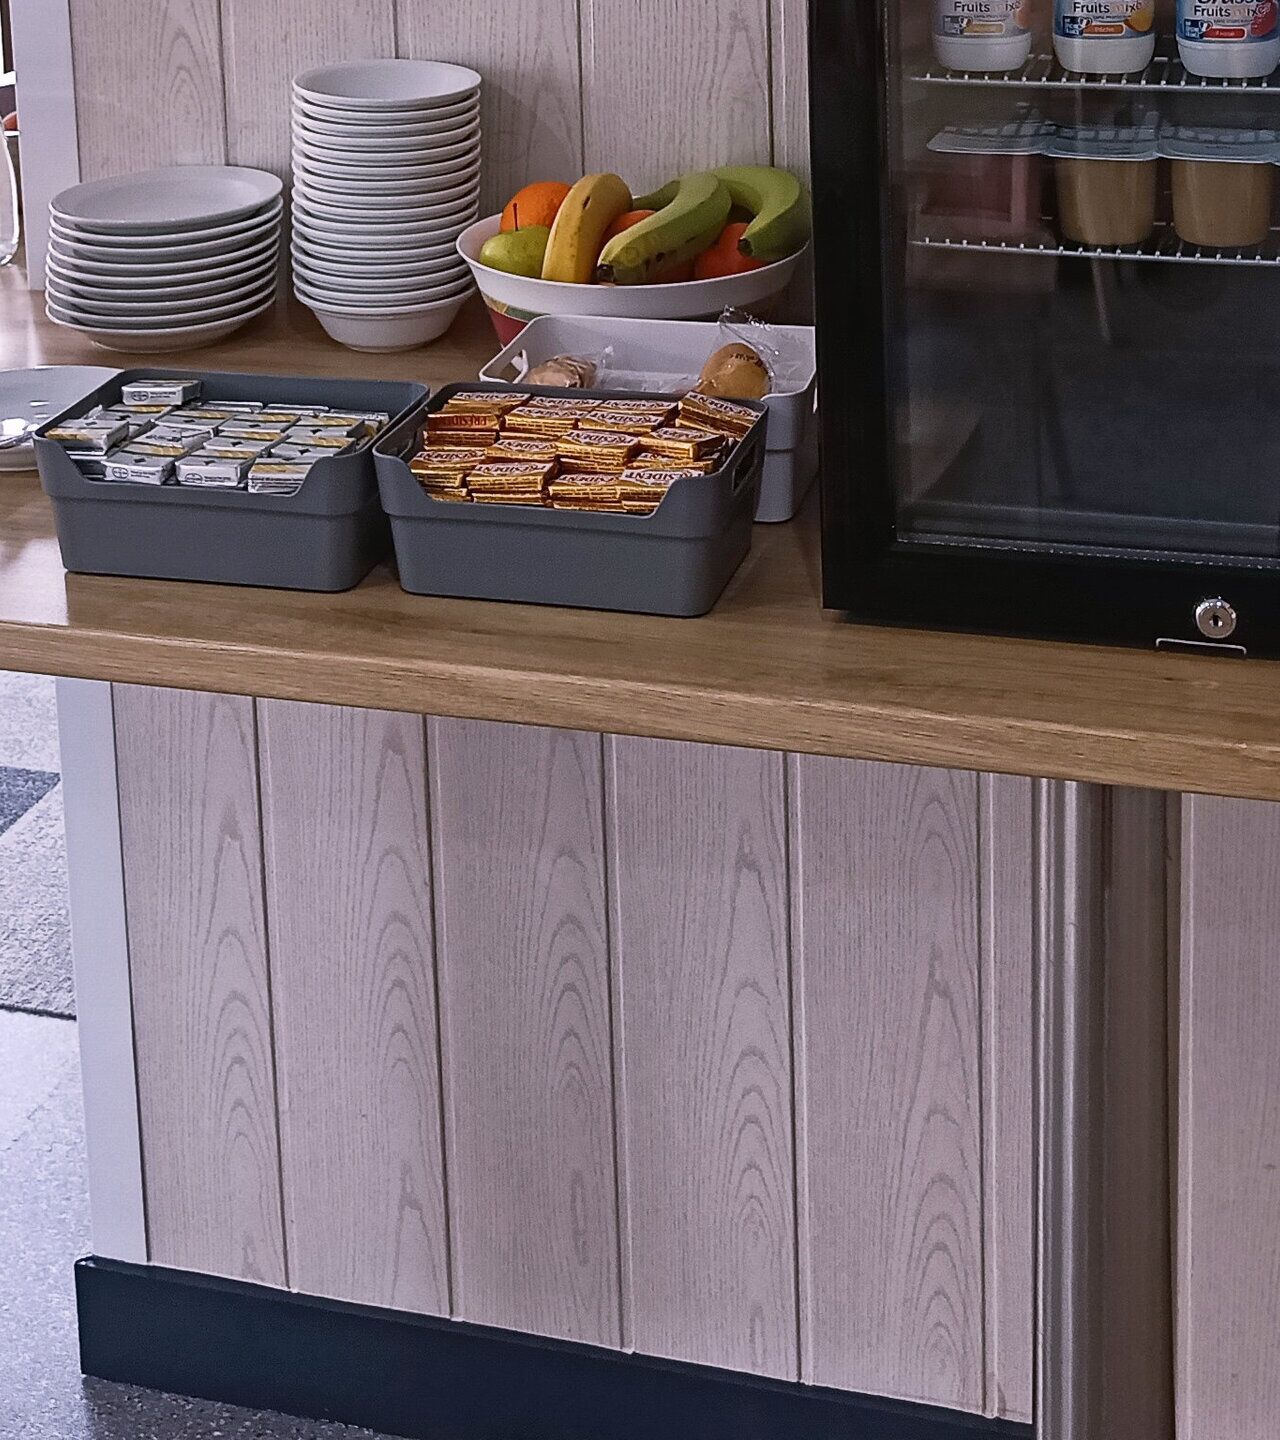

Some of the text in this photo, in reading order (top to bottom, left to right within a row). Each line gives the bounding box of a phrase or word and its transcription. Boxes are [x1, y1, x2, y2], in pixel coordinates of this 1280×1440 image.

[954, 1, 990, 13] Fruits
[1073, 2, 1110, 13] Fruits
[1194, 5, 1231, 17] Fruits
